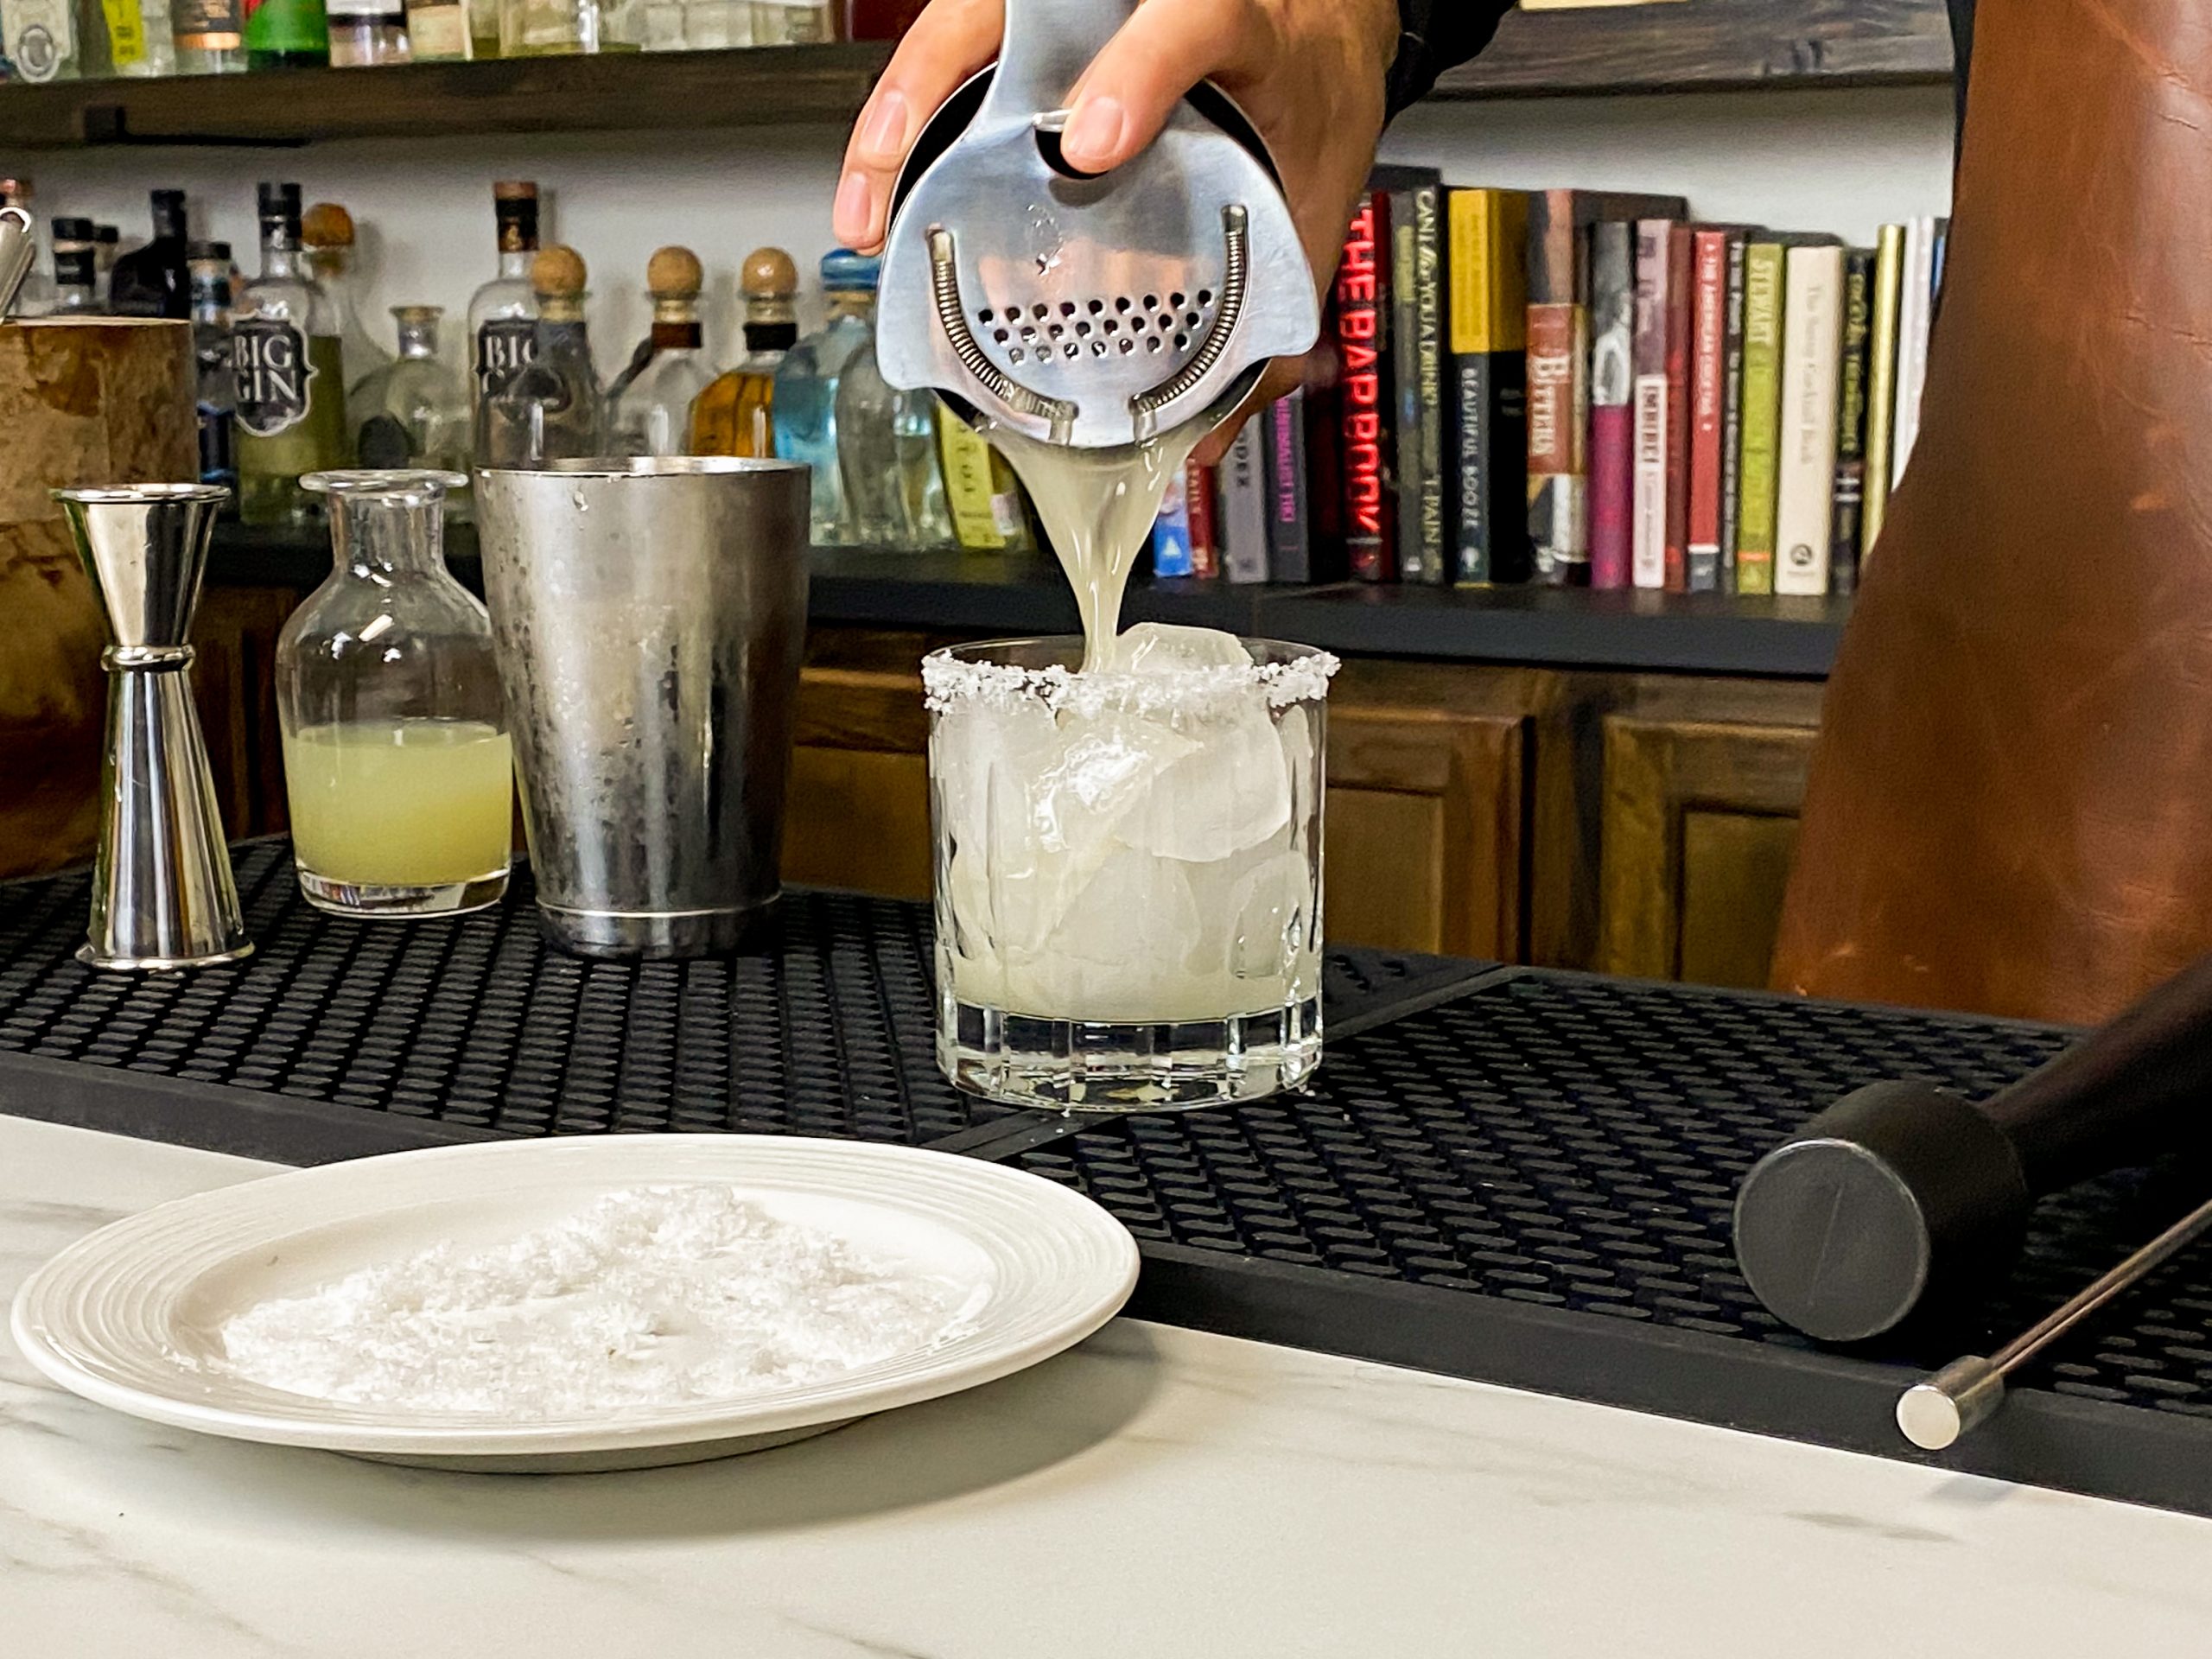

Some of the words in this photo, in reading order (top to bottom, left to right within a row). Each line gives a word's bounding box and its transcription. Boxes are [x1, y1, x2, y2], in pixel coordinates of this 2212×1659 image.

[1416, 191, 1436, 232] CAN
[1339, 208, 1376, 302] THE
[1419, 282, 1438, 322] YOU
[1747, 260, 1776, 346] STEWART
[234, 334, 293, 372] BIG
[234, 369, 298, 403] GIN
[1340, 309, 1378, 404] BAR
[1460, 367, 1480, 459] BEAUTIFUL
[1235, 428, 1252, 489] ODEX
[1344, 413, 1382, 533] BOOK
